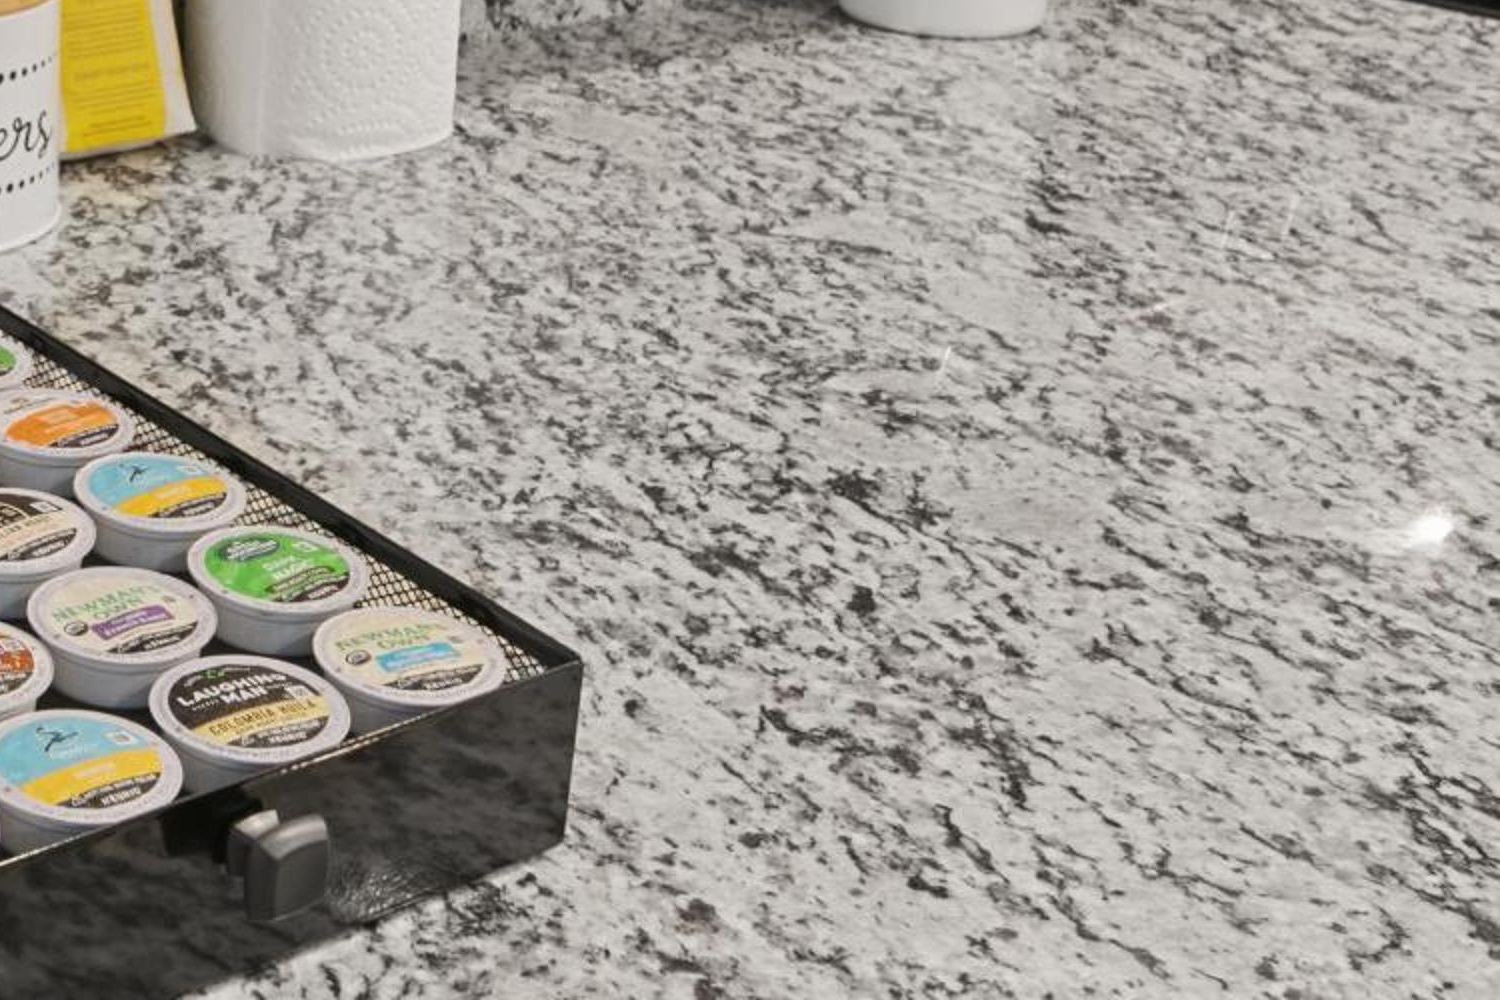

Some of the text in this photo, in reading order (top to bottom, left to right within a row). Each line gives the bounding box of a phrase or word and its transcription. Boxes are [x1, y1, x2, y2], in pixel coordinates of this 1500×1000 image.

[176, 672, 288, 708] LAUGHING
[218, 684, 269, 705] MAN
[208, 707, 276, 737] COLOMBIA
